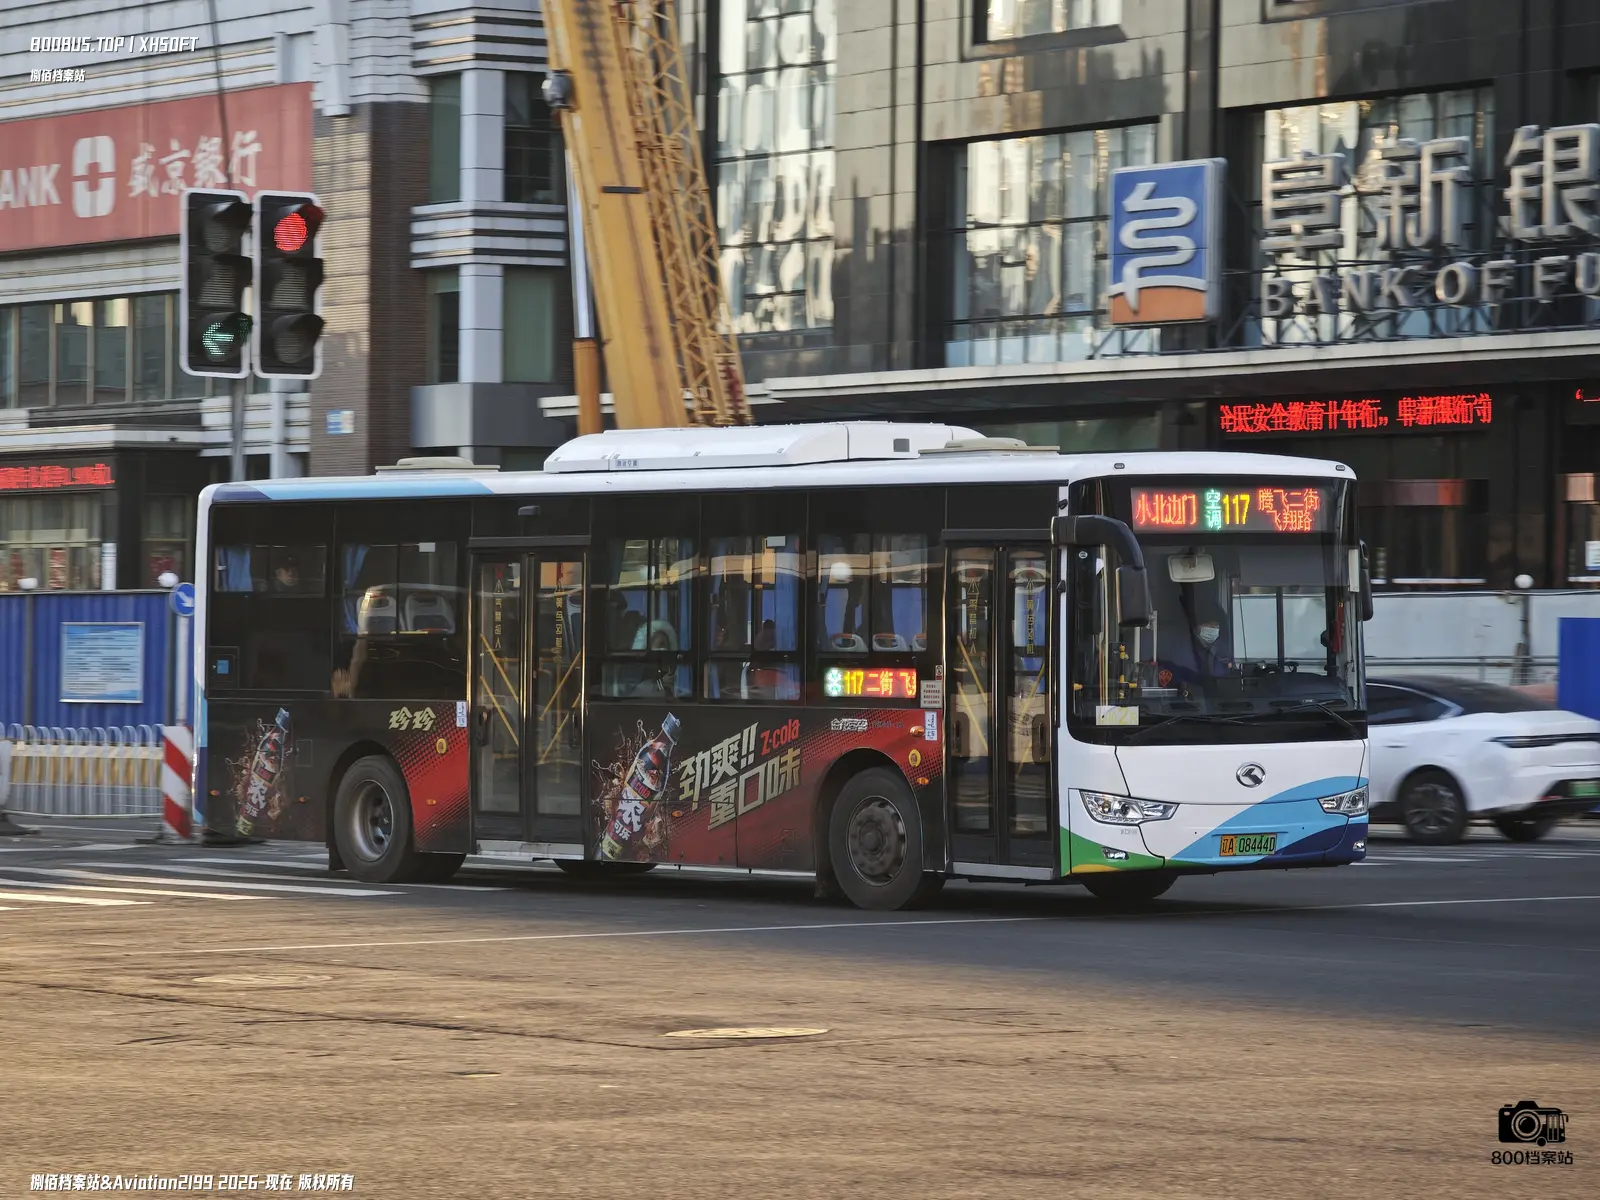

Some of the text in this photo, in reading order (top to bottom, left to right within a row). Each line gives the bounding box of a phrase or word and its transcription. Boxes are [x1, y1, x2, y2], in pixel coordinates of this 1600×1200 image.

[1260, 123, 1600, 260] 阜新银
[1260, 266, 1428, 319] BANK
[1435, 258, 1517, 308] OF
[1135, 494, 1197, 525] 小北边门
[1204, 489, 1224, 530] 空调
[1222, 494, 1250, 525] 117
[1258, 488, 1320, 511] 腾飞二街
[1266, 509, 1313, 532] 飞翔路
[843, 670, 864, 695] 117
[866, 670, 893, 696] 二街
[388, 706, 437, 731] 珍珍
[707, 747, 801, 831] 重口味
[1238, 836, 1276, 853] 08444D
